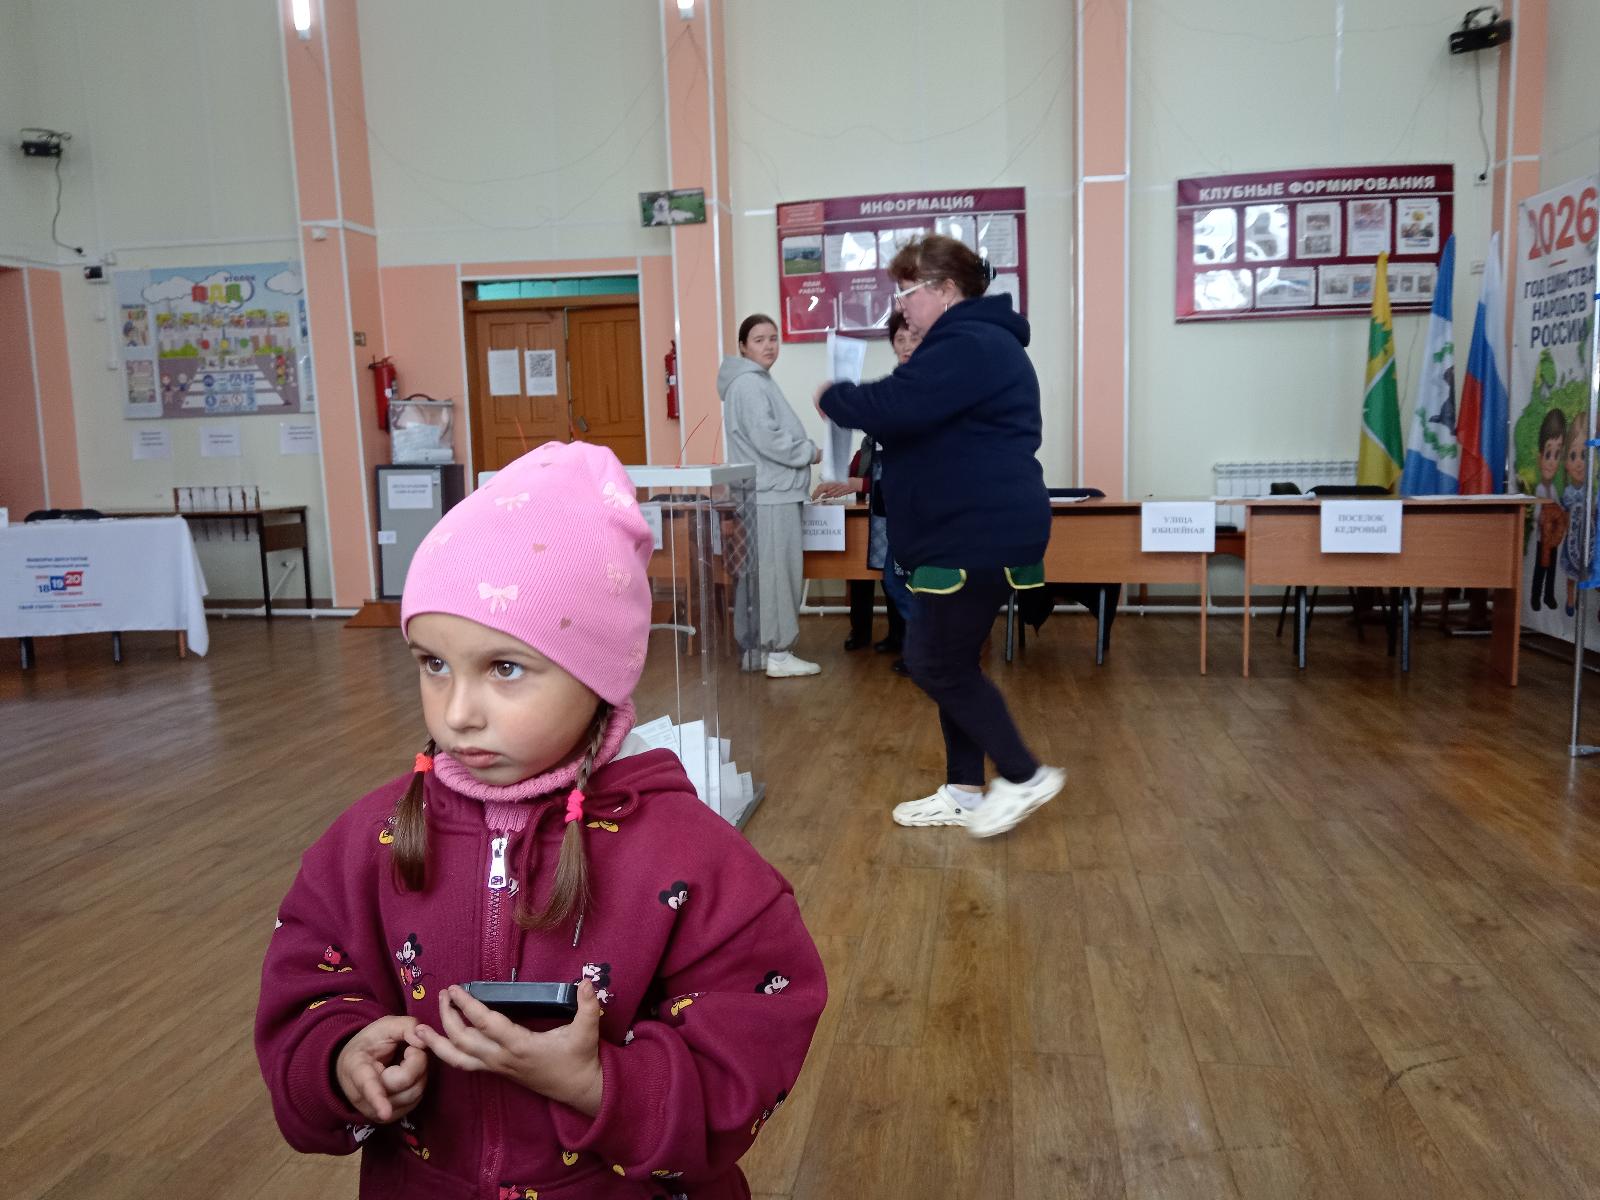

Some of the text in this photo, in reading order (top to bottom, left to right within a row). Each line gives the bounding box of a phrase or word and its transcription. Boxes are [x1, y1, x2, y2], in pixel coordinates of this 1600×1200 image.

[1199, 175, 1436, 201] КЛУБНЫЕ ФОРМИРОВАНИЯ
[860, 195, 975, 215] ИНФОРМАЦИЯ
[1528, 187, 1598, 260] 2026
[1524, 279, 1545, 299] ГОД
[1532, 291, 1587, 322] НАРОДОВ
[1530, 317, 1588, 348] РОССИИ
[1164, 516, 1193, 524] УЛИЦА
[38, 574, 81, 593] 18 19 20
